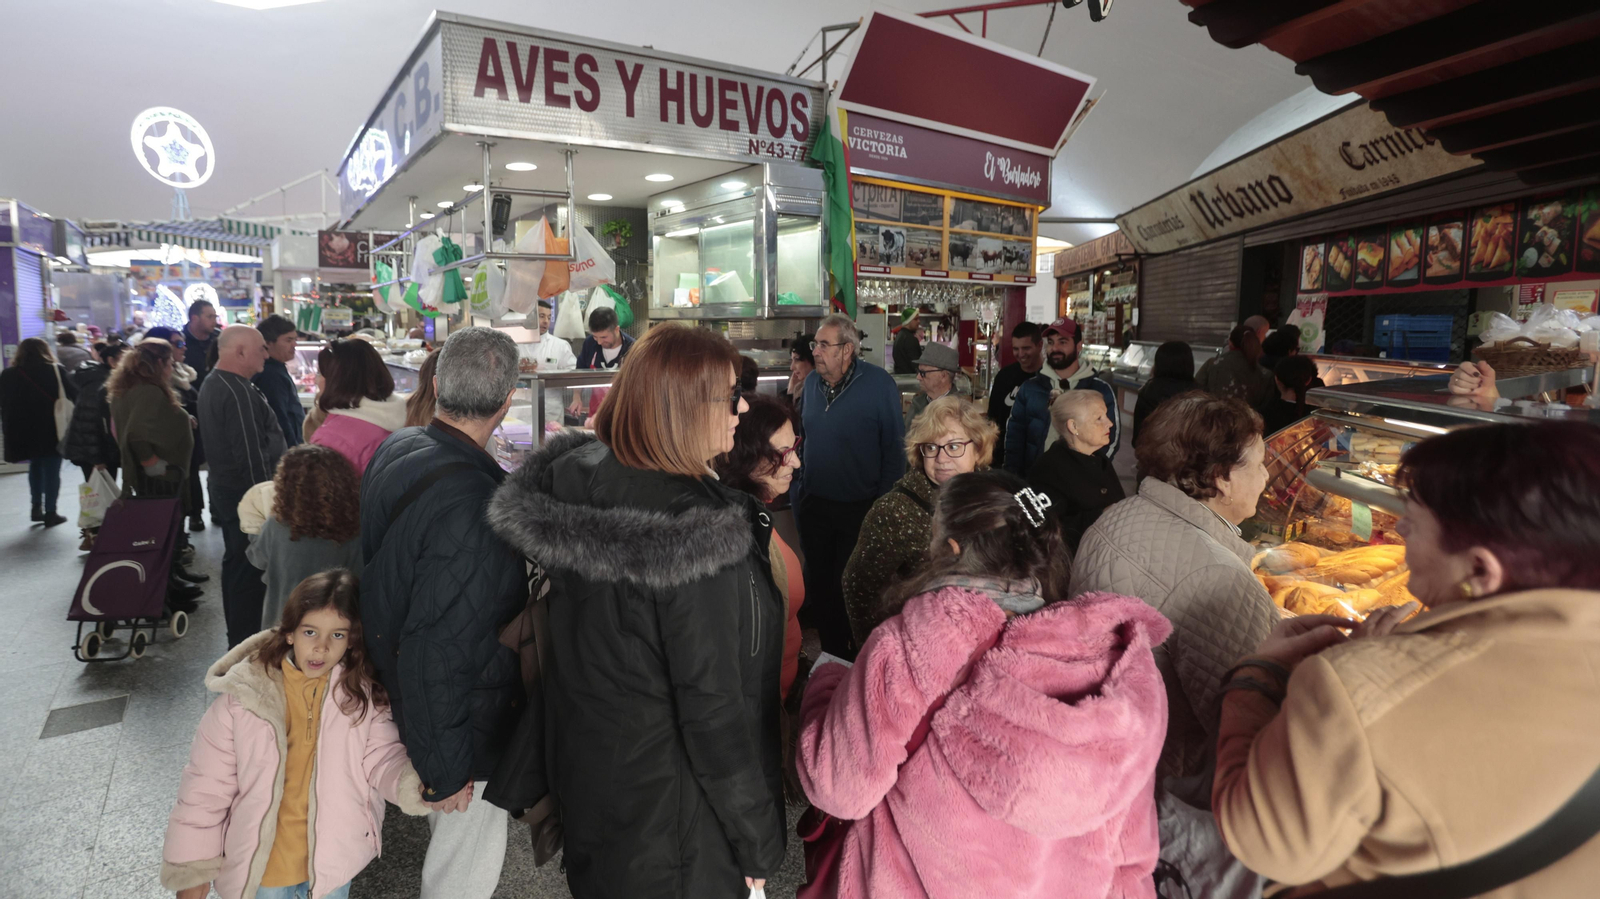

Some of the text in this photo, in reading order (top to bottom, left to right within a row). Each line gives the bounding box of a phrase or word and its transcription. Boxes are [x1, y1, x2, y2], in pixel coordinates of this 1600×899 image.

[394, 61, 440, 150] C.B.
[473, 37, 810, 142] AVES Y HUEVOS
[848, 136, 908, 159] VICTORIA
[853, 126, 904, 145] CERVEZAS
[984, 151, 1042, 189] El Burladero
[1190, 174, 1294, 229] Urbano
